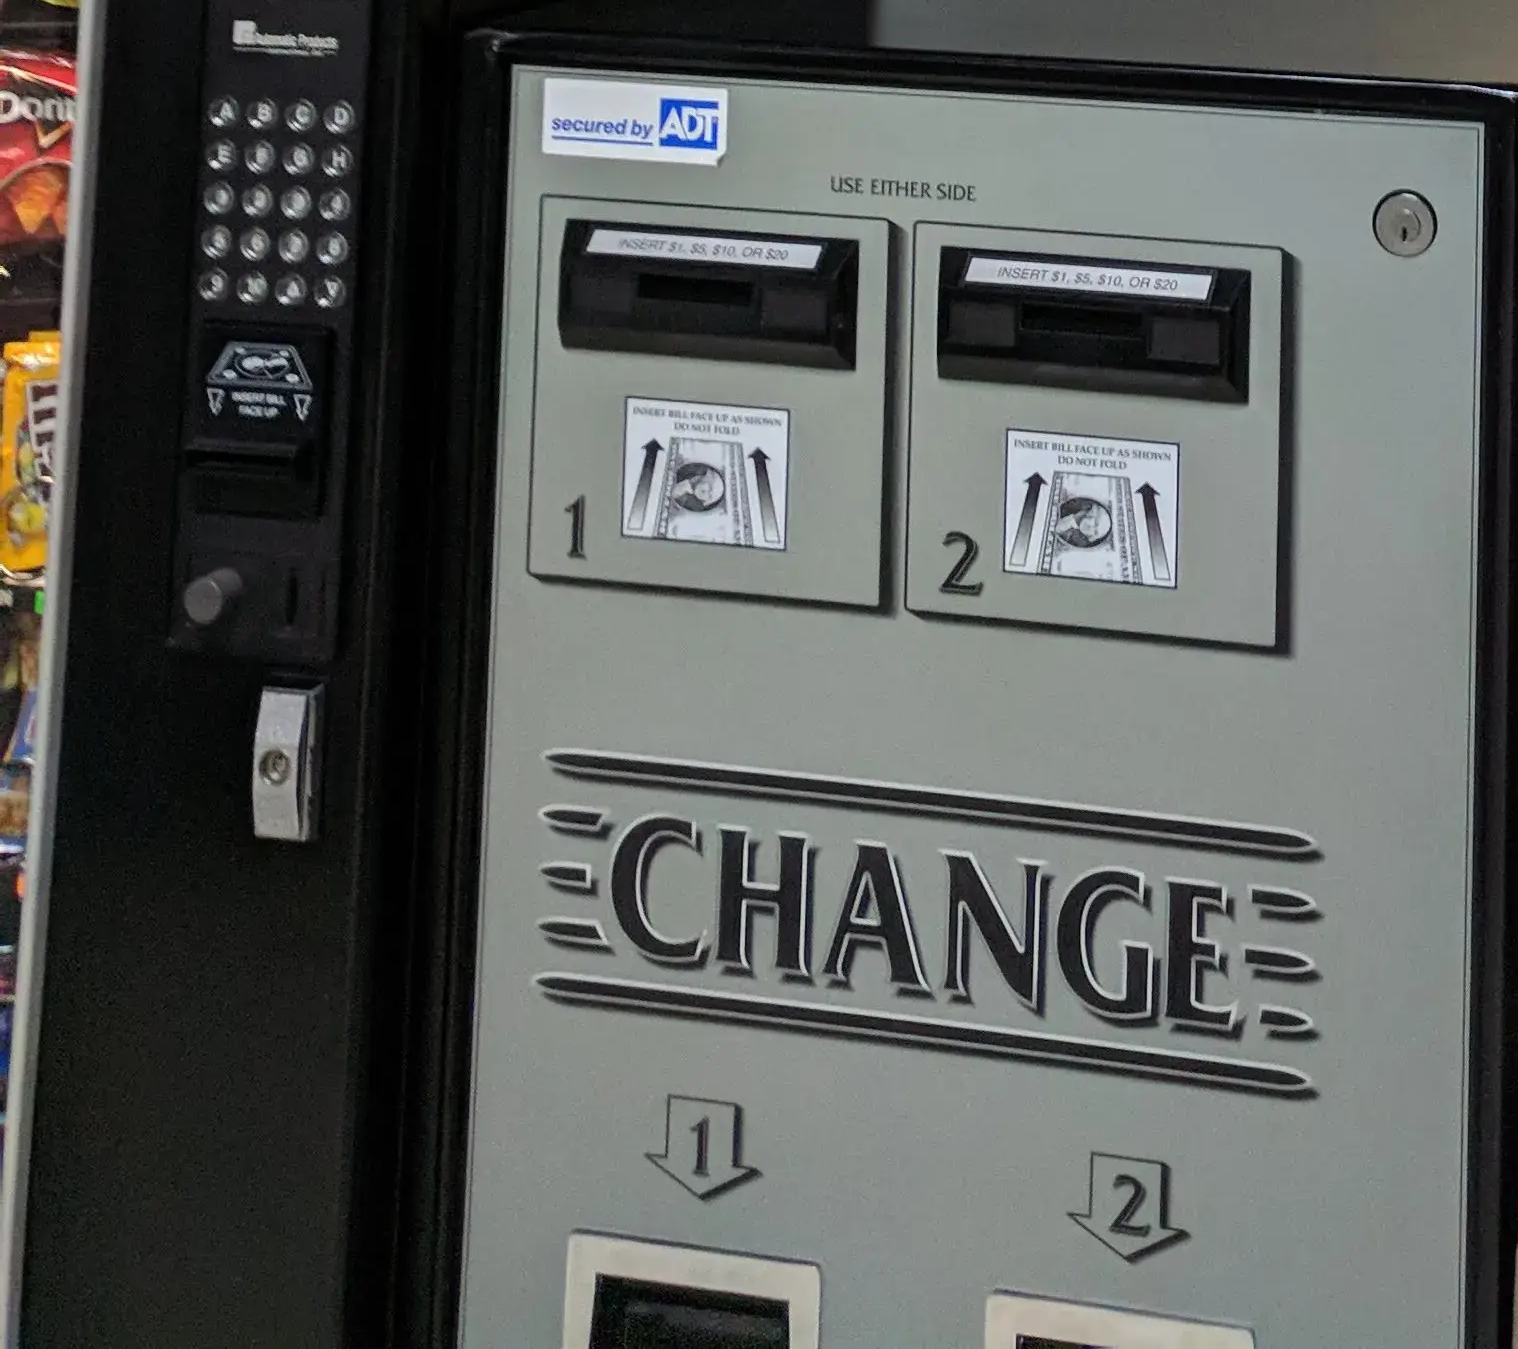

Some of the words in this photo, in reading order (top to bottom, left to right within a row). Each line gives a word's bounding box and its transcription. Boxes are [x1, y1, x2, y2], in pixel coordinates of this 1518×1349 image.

[219, 102, 236, 120] A
[257, 102, 272, 122] B
[334, 106, 350, 125] D
[551, 117, 627, 136] secured
[630, 119, 654, 139] by
[660, 105, 718, 144] ADT
[331, 148, 347, 169] H
[831, 175, 864, 195] USE
[870, 177, 932, 199] EITHER
[936, 181, 978, 202] SIDE
[618, 237, 666, 252] INSERT
[741, 245, 764, 259] OR
[764, 246, 790, 262] $20
[997, 266, 1048, 283] INSERT
[1051, 270, 1070, 284] $1,
[1074, 272, 1094, 286] $5,
[1097, 273, 1125, 289] $10,
[1128, 276, 1151, 290] OR
[1153, 278, 1179, 292] $20
[632, 406, 666, 417] INSERT
[668, 409, 689, 420] BILL
[690, 411, 714, 422] FACE
[715, 413, 729, 423] UP
[731, 414, 744, 424] AS
[744, 415, 782, 427] SHOWN
[674, 423, 689, 433] DO
[691, 424, 711, 434] NOT
[714, 426, 740, 436] FOLD
[1013, 438, 1049, 451] INSERT
[1051, 442, 1072, 453] BILL
[1074, 444, 1099, 456] FACE
[1101, 446, 1115, 457] UP
[1117, 448, 1130, 458] AS
[1131, 450, 1172, 463] SHOWN
[1057, 455, 1074, 466] DO
[1075, 457, 1097, 468] NOT
[1100, 460, 1127, 471] FOLD
[563, 494, 588, 561] 1
[938, 530, 986, 598] 2
[607, 812, 1249, 1039] CHANGE
[687, 1114, 713, 1180] 1
[1108, 1172, 1153, 1238] 2
